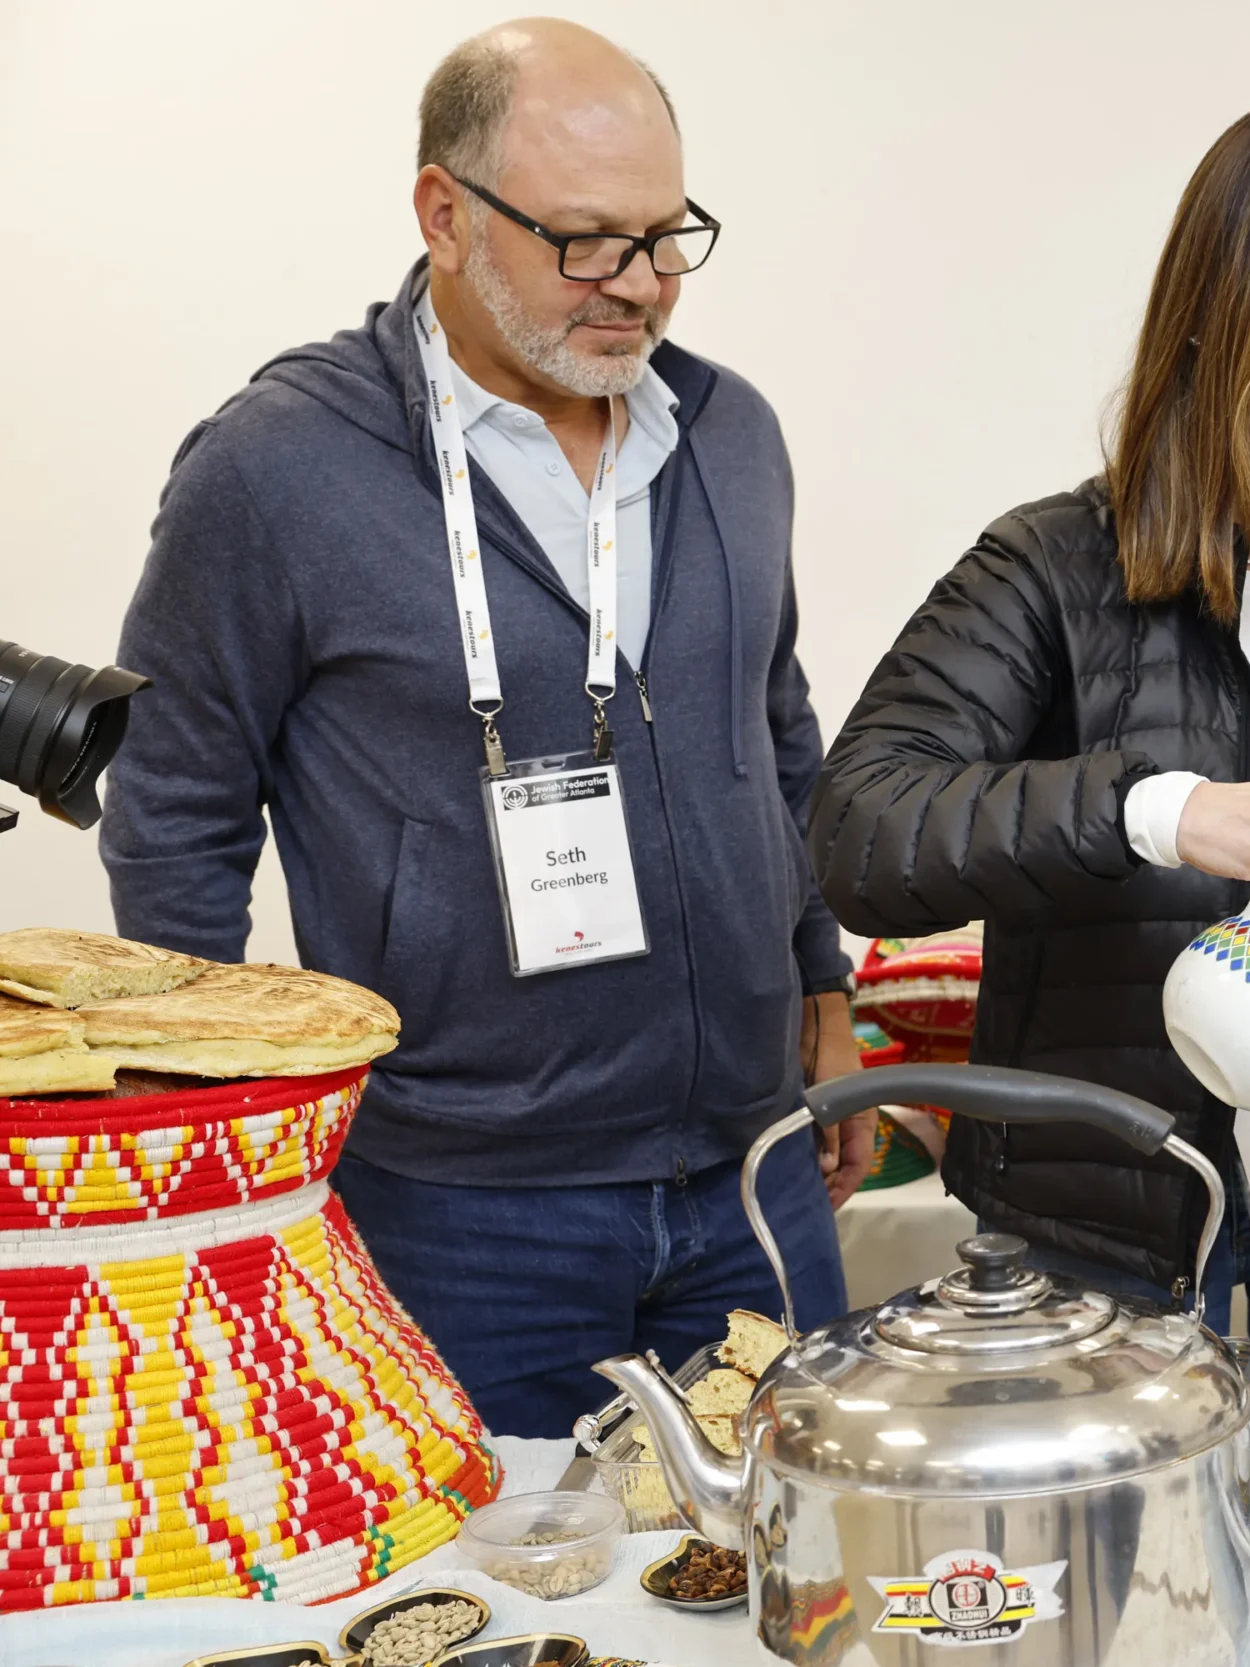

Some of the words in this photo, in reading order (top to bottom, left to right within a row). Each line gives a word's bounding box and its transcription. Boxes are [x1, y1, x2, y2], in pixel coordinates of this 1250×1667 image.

[430, 380, 442, 423] kenestours
[442, 450, 454, 496] kenestours
[454, 530, 465, 578] kenestours
[465, 610, 478, 659] kenestours
[595, 608, 603, 657] kenestours
[531, 782, 561, 795] Jewish
[563, 776, 609, 790] Federation
[531, 794, 540, 802] of
[541, 791, 569, 800] Greater
[570, 787, 595, 797] Atlanta
[546, 847, 586, 866] Seth
[530, 871, 609, 892] Greenberg
[555, 941, 602, 954] kenestours
